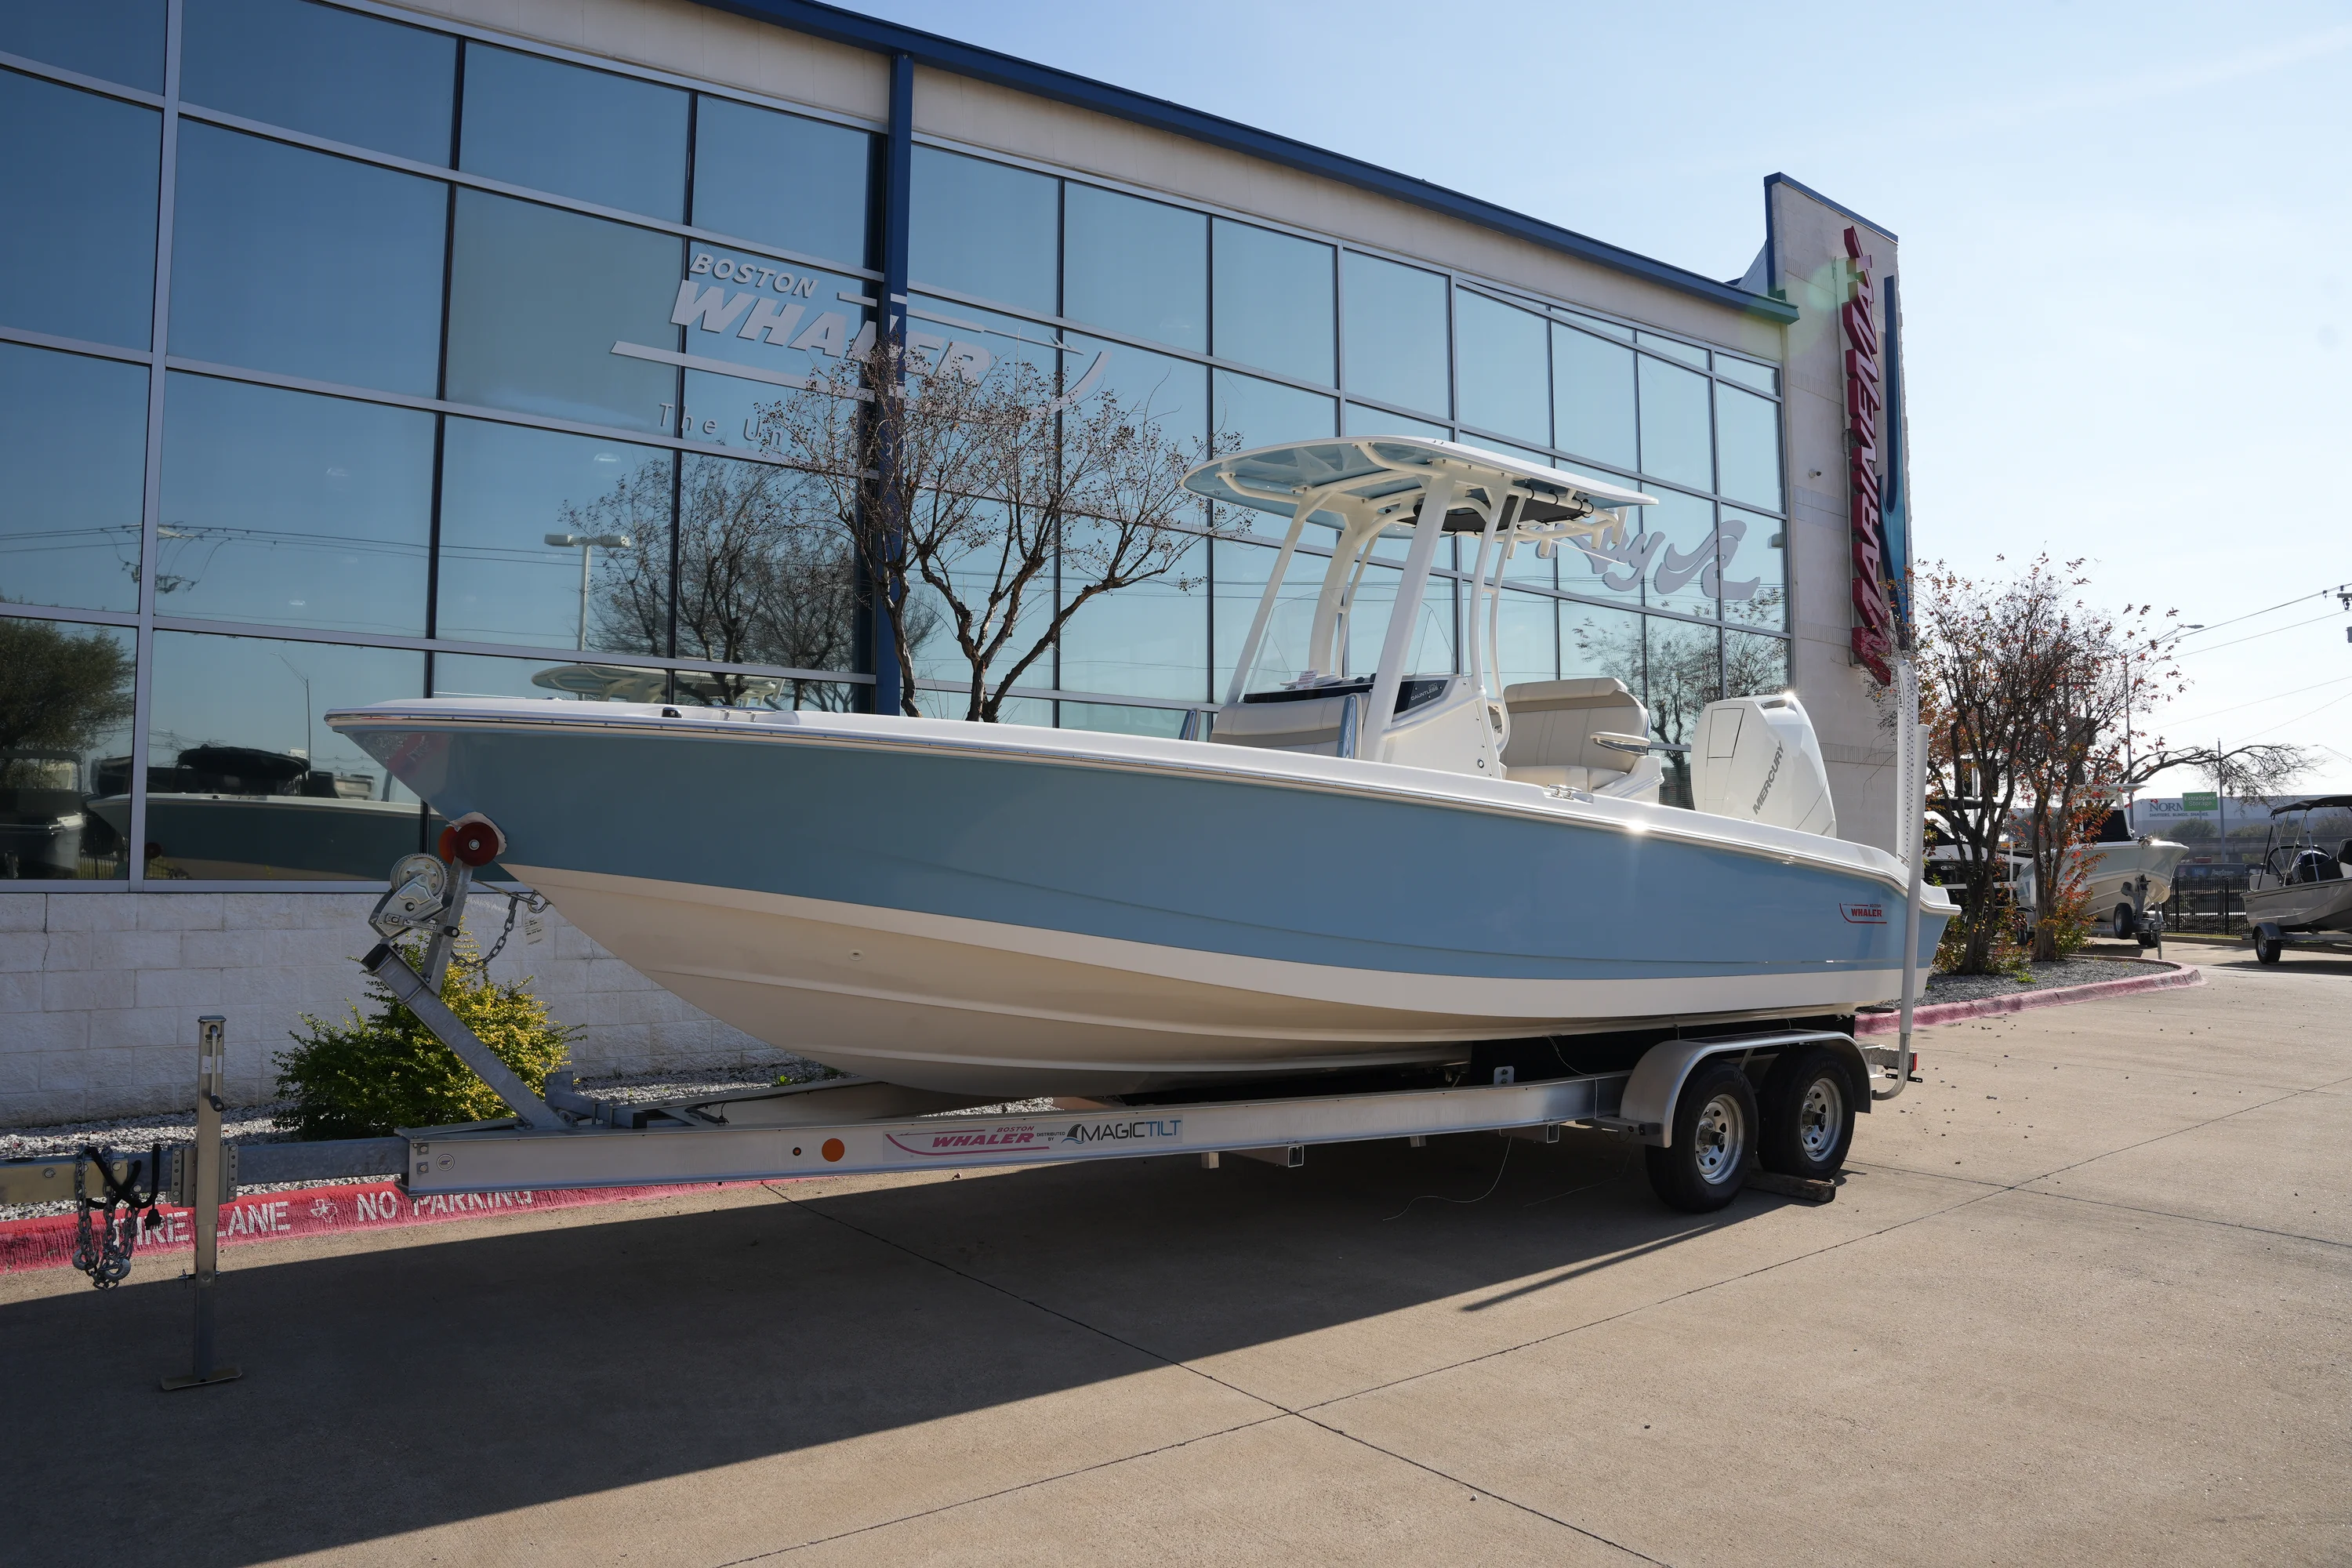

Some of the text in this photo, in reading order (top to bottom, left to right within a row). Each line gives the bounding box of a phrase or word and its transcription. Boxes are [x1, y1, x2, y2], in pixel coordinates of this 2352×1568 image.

[689, 252, 818, 299] BOSTON
[659, 402, 717, 434] The
[1411, 686, 1438, 700] DAUNTLESS
[1752, 740, 1784, 815] MERCURY
[1851, 908, 1882, 917] WHALER
[932, 1133, 1034, 1147] WHALER
[1081, 1120, 1181, 1142] MAGICTILT
[217, 1201, 291, 1236] ANE
[357, 1191, 397, 1221] NO
